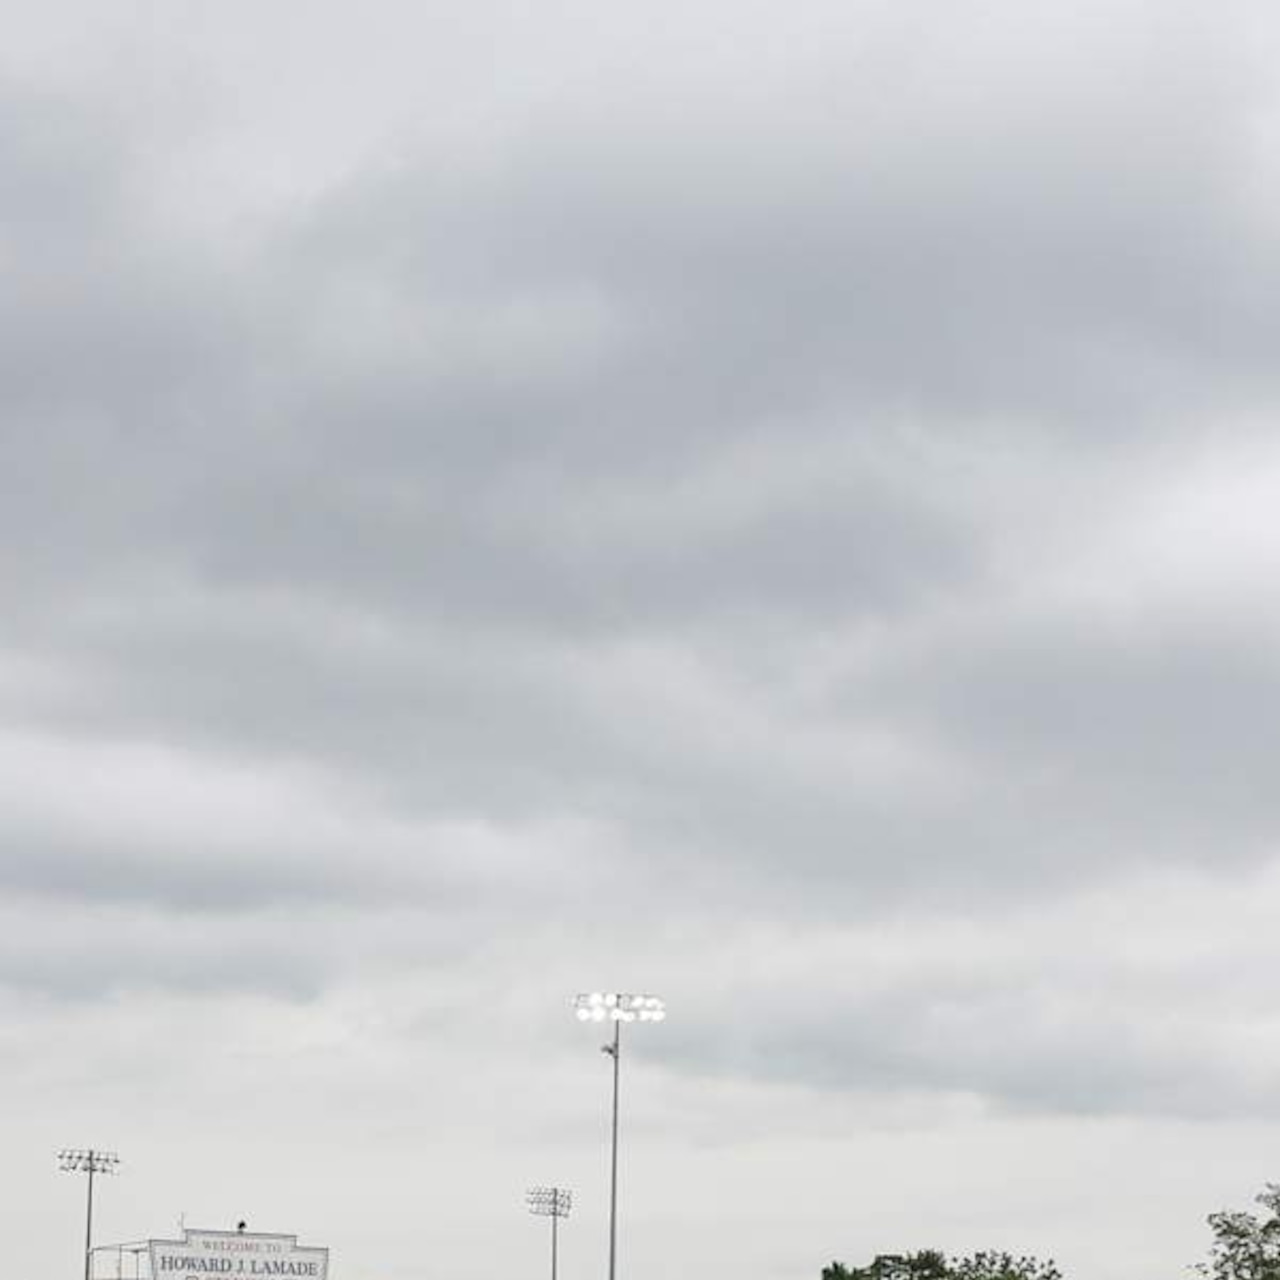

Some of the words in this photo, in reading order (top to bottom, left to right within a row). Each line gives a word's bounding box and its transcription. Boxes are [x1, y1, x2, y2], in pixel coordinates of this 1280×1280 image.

[202, 1240, 260, 1252] WELCOME
[265, 1243, 282, 1253] TO
[161, 1255, 232, 1272] HOWARD
[250, 1260, 319, 1276] LAMADE
